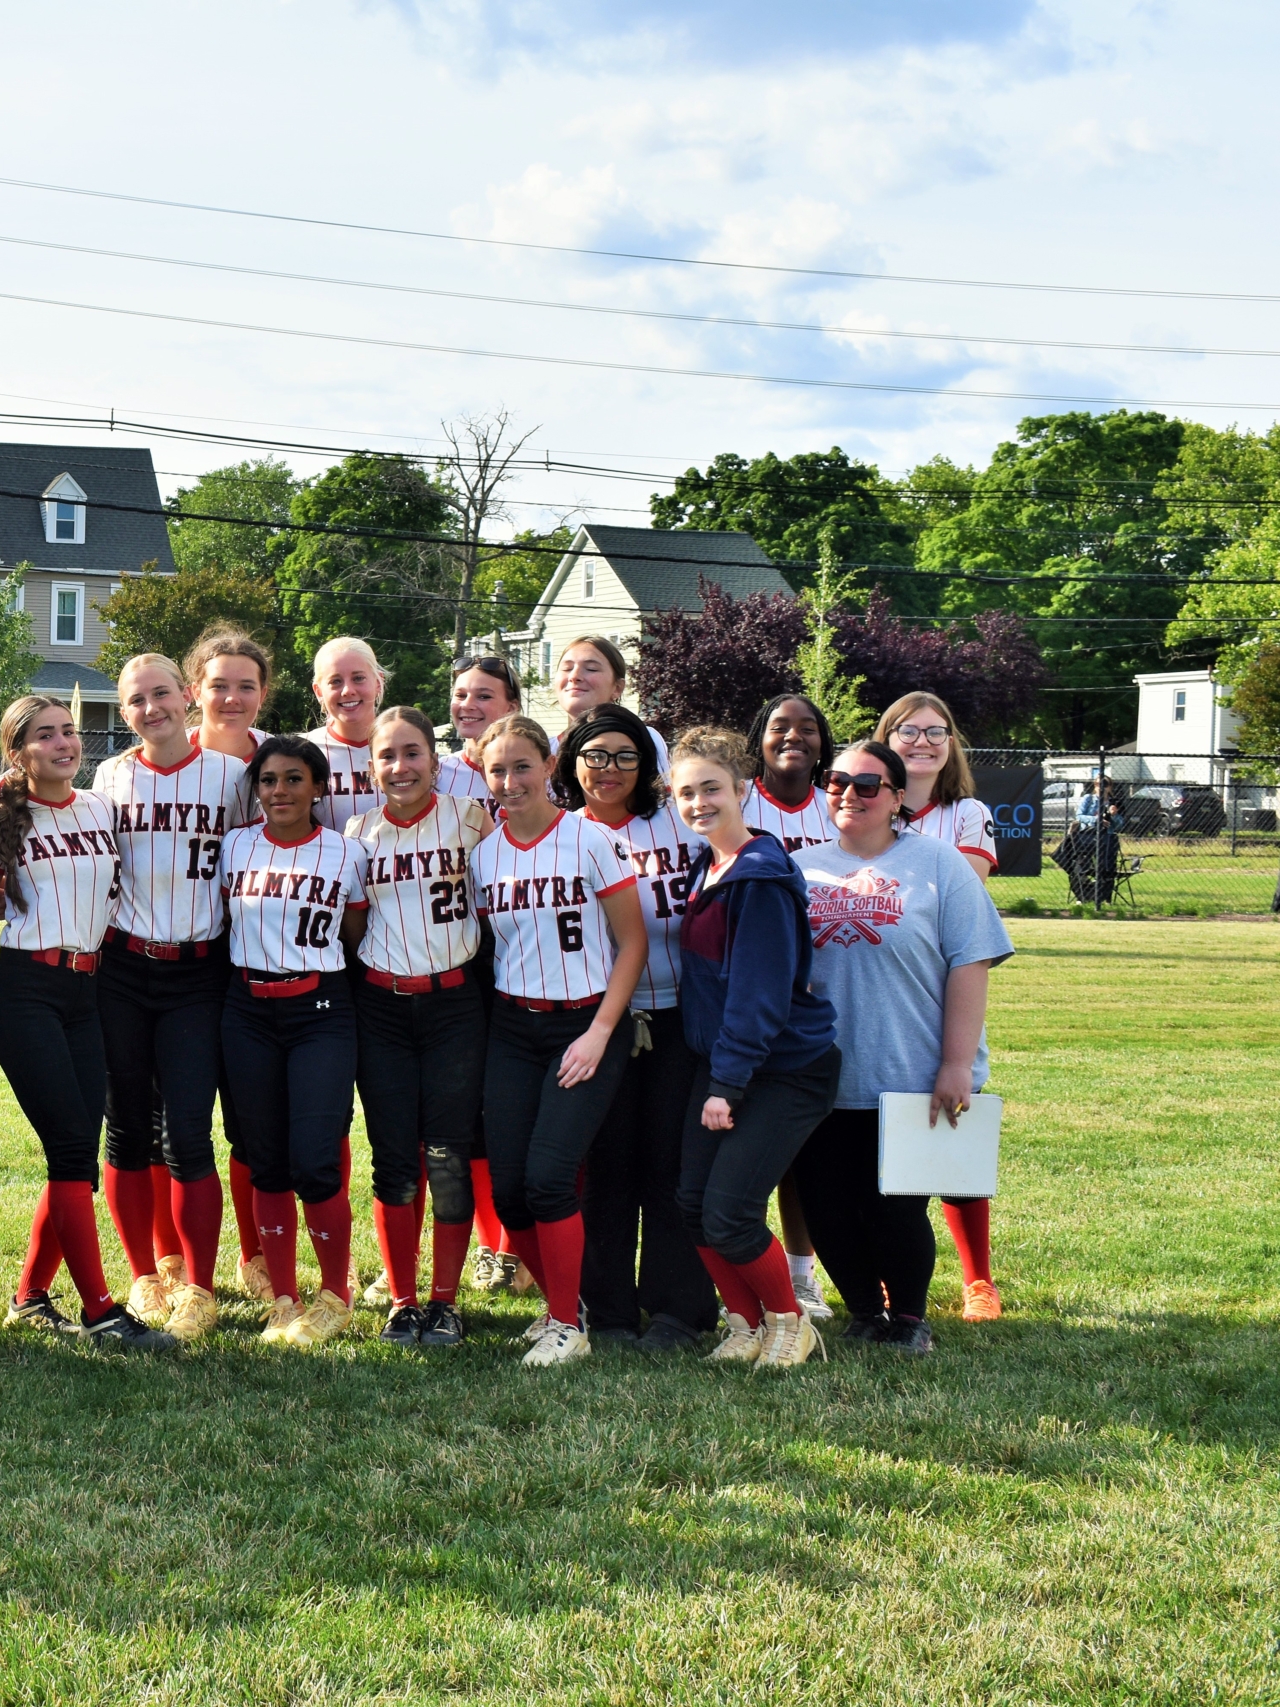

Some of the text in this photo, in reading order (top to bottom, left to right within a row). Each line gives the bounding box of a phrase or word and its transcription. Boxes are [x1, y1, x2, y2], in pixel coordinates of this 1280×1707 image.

[112, 803, 226, 836] ALMYRA
[986, 803, 1035, 826] CO
[187, 838, 221, 880] 13
[429, 878, 469, 925] 23
[821, 911, 875, 922] TOURNAMENT
[851, 895, 904, 915] SOFTBALL
[294, 906, 333, 949] 10
[557, 910, 584, 953] 6
